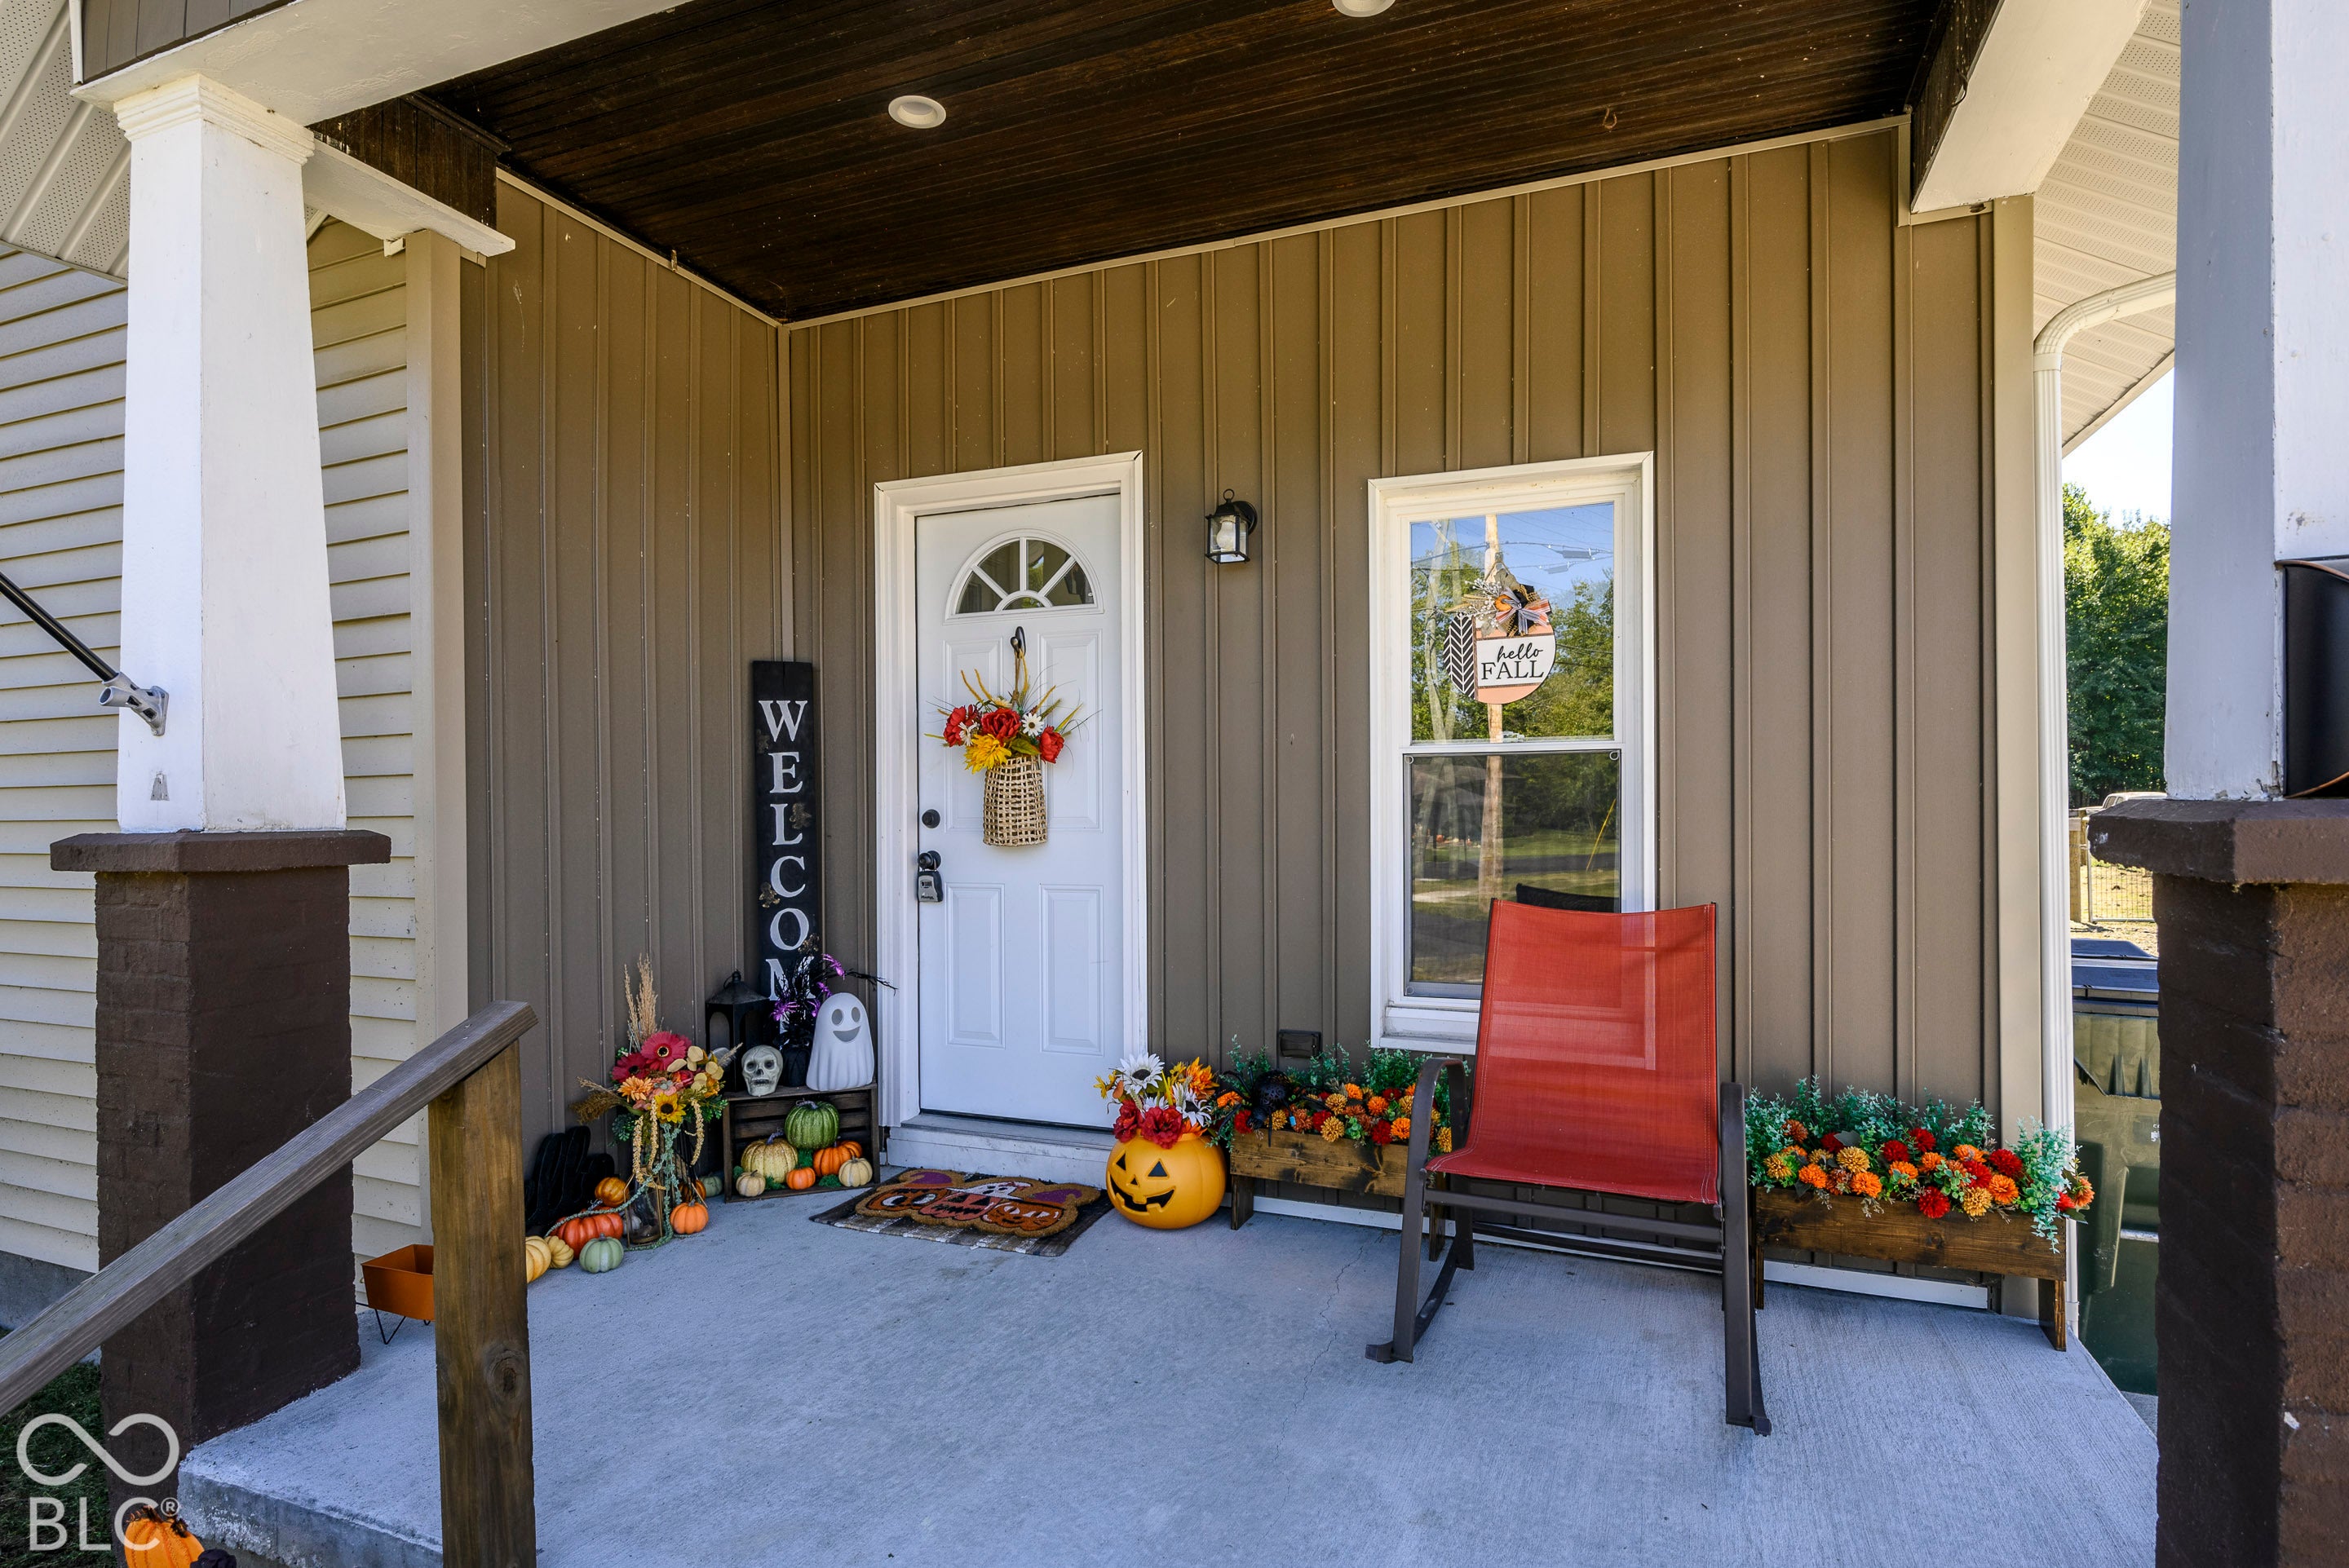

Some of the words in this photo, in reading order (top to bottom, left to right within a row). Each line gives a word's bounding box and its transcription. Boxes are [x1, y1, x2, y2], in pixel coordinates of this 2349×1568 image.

[1497, 643, 1543, 662] hello
[1481, 660, 1544, 679] FALL
[758, 700, 816, 1034] WELCOM
